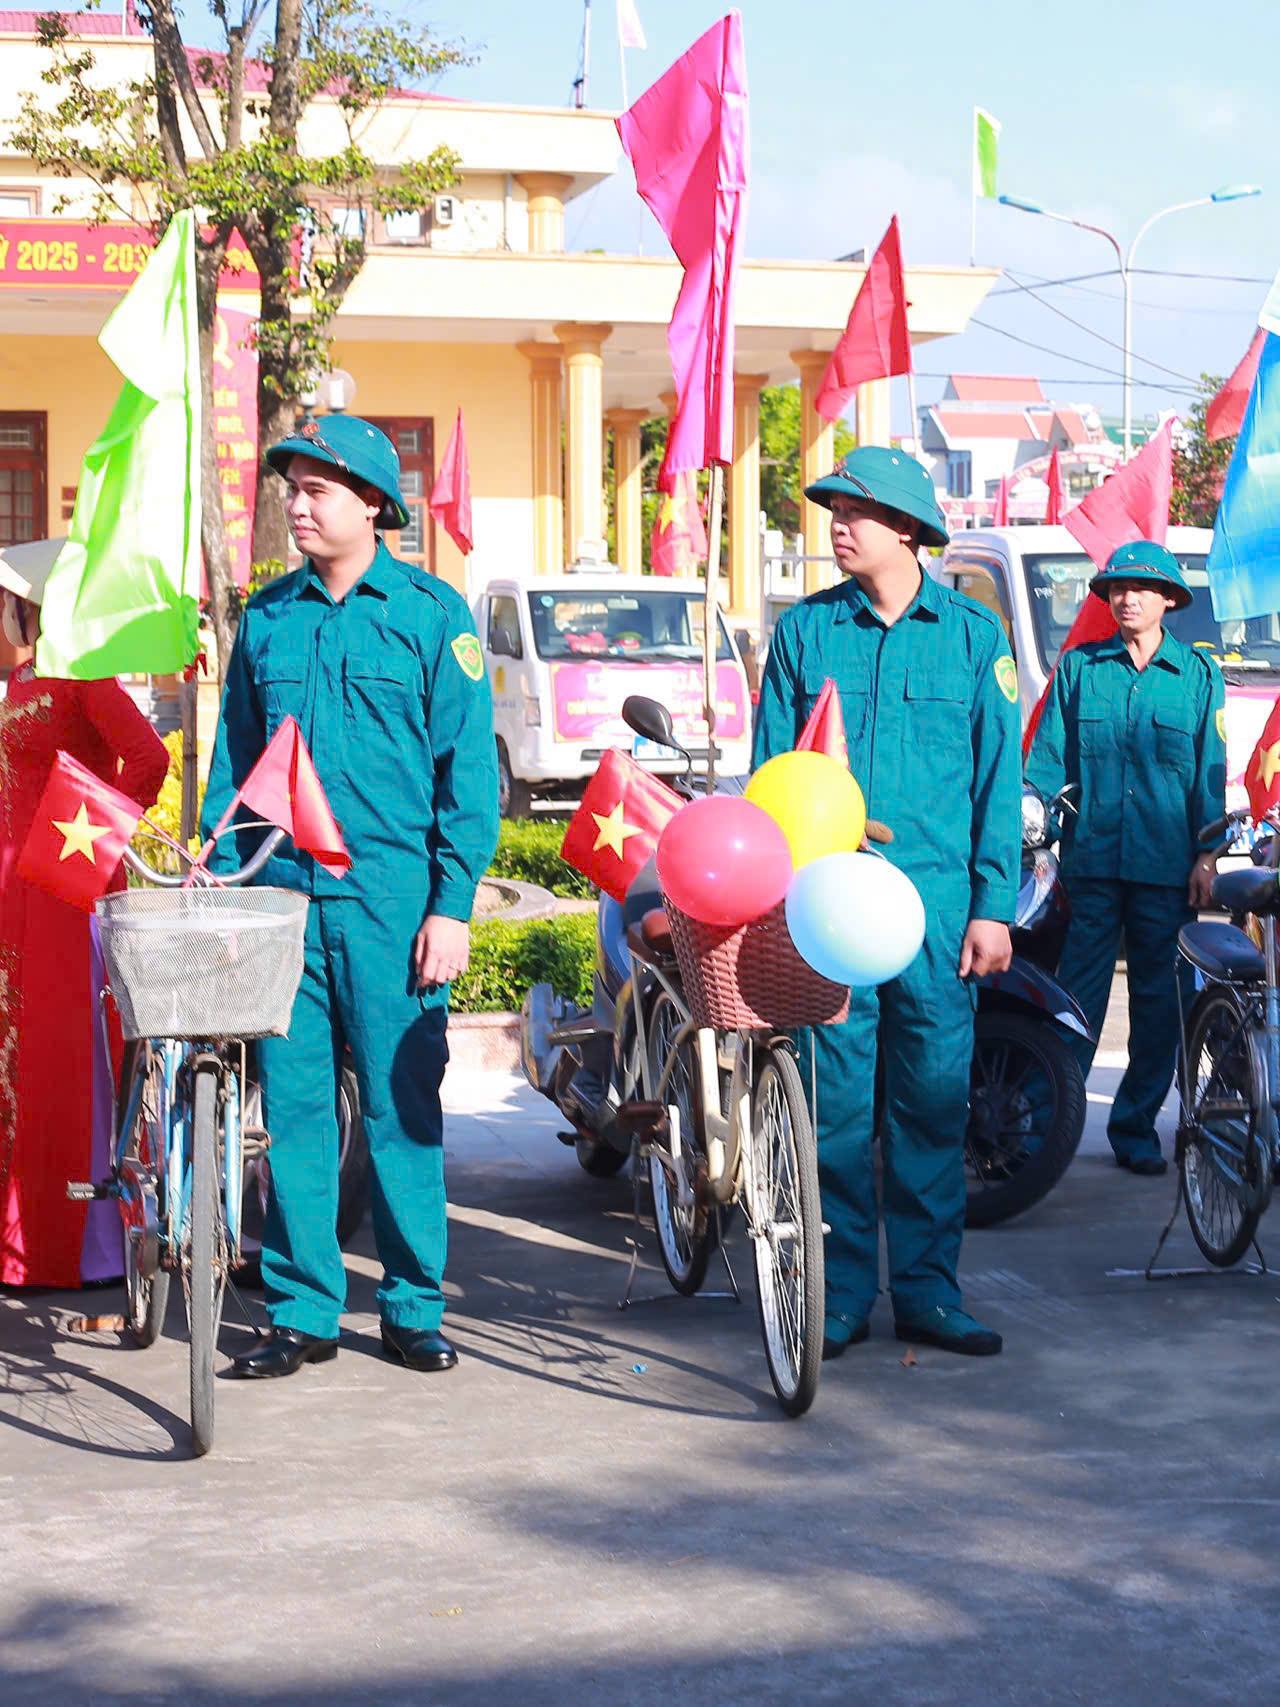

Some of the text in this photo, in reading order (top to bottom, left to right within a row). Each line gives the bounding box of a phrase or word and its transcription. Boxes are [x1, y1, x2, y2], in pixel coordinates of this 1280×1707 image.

[17, 240, 78, 271] 2025
[85, 255, 96, 263] -
[103, 242, 152, 273] 203
